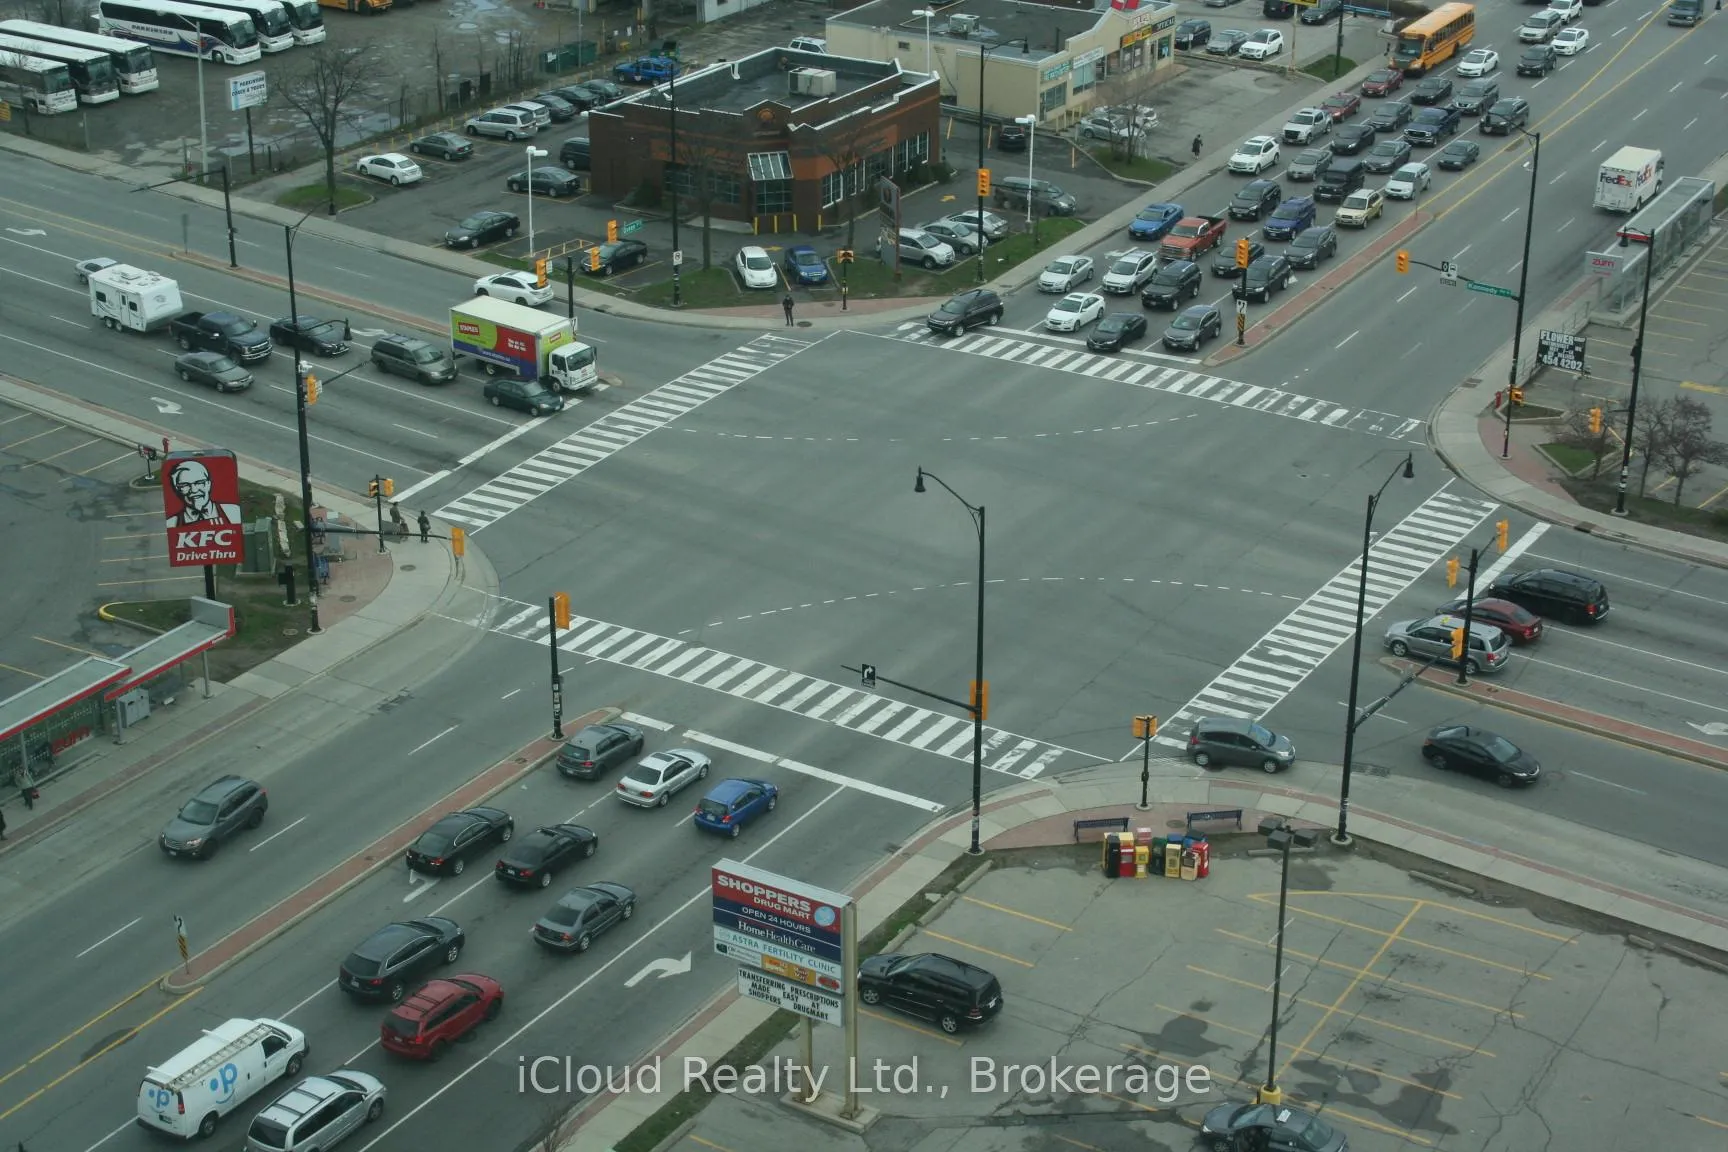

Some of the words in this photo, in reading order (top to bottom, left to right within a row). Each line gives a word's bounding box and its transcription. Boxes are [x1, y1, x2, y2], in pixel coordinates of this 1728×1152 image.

[1600, 172, 1633, 187] FedEx
[1540, 331, 1574, 346] FLOWER
[1542, 354, 1559, 367] 454
[1560, 358, 1583, 371] 4202
[175, 529, 233, 549] KFC
[176, 550, 208, 562] Drive
[209, 549, 236, 560] Thru
[717, 874, 811, 913] SHOPPERS
[742, 906, 767, 920] OPEN
[768, 914, 778, 924] 24
[779, 917, 811, 934] HOURS
[753, 896, 782, 911] DRUG
[783, 905, 810, 920] MART
[732, 934, 759, 949] ASTRA
[763, 943, 803, 963] FERTILITY
[807, 956, 835, 974] CLINIC
[738, 969, 786, 991] TRANSFERRING
[790, 985, 839, 1008] PRESCRIPTIONS
[751, 982, 770, 994] MADE
[782, 991, 799, 1003] EASY
[811, 1001, 820, 1010] AT
[748, 988, 782, 1005] SHOPPERS
[793, 1003, 829, 1021] DRUGMART
